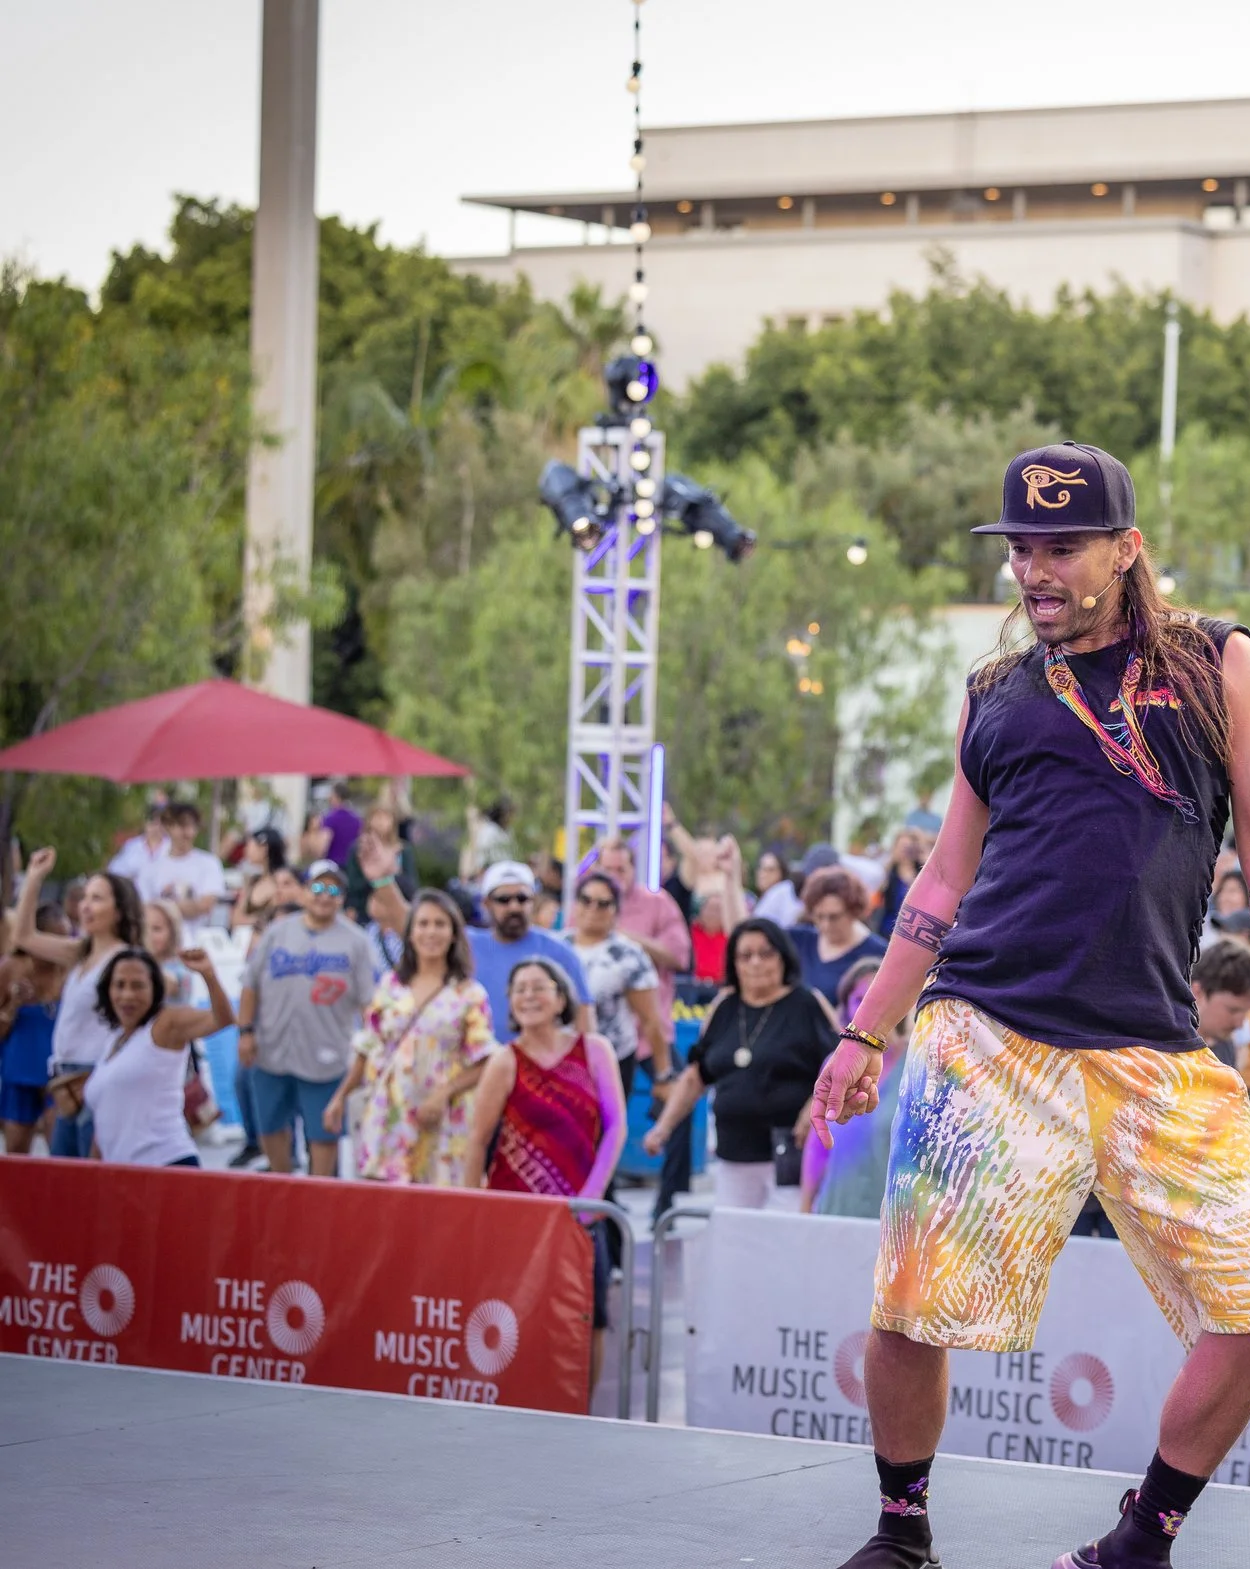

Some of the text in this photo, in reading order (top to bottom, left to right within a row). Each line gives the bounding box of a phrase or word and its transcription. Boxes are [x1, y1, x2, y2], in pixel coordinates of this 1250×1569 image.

[28, 1261, 77, 1295] THE
[214, 1277, 266, 1312] THE
[180, 1311, 264, 1350] MUSIC
[411, 1295, 462, 1331] THE
[27, 1333, 119, 1364] CENTER
[374, 1330, 461, 1370] MUSIC
[778, 1326, 829, 1361] THE
[211, 1353, 306, 1384] CENTER
[731, 1363, 828, 1402] MUSIC
[994, 1352, 1046, 1383] THE
[407, 1372, 499, 1405] CENTER
[950, 1386, 1044, 1425] MUSIC
[986, 1431, 1094, 1468] CENTER
